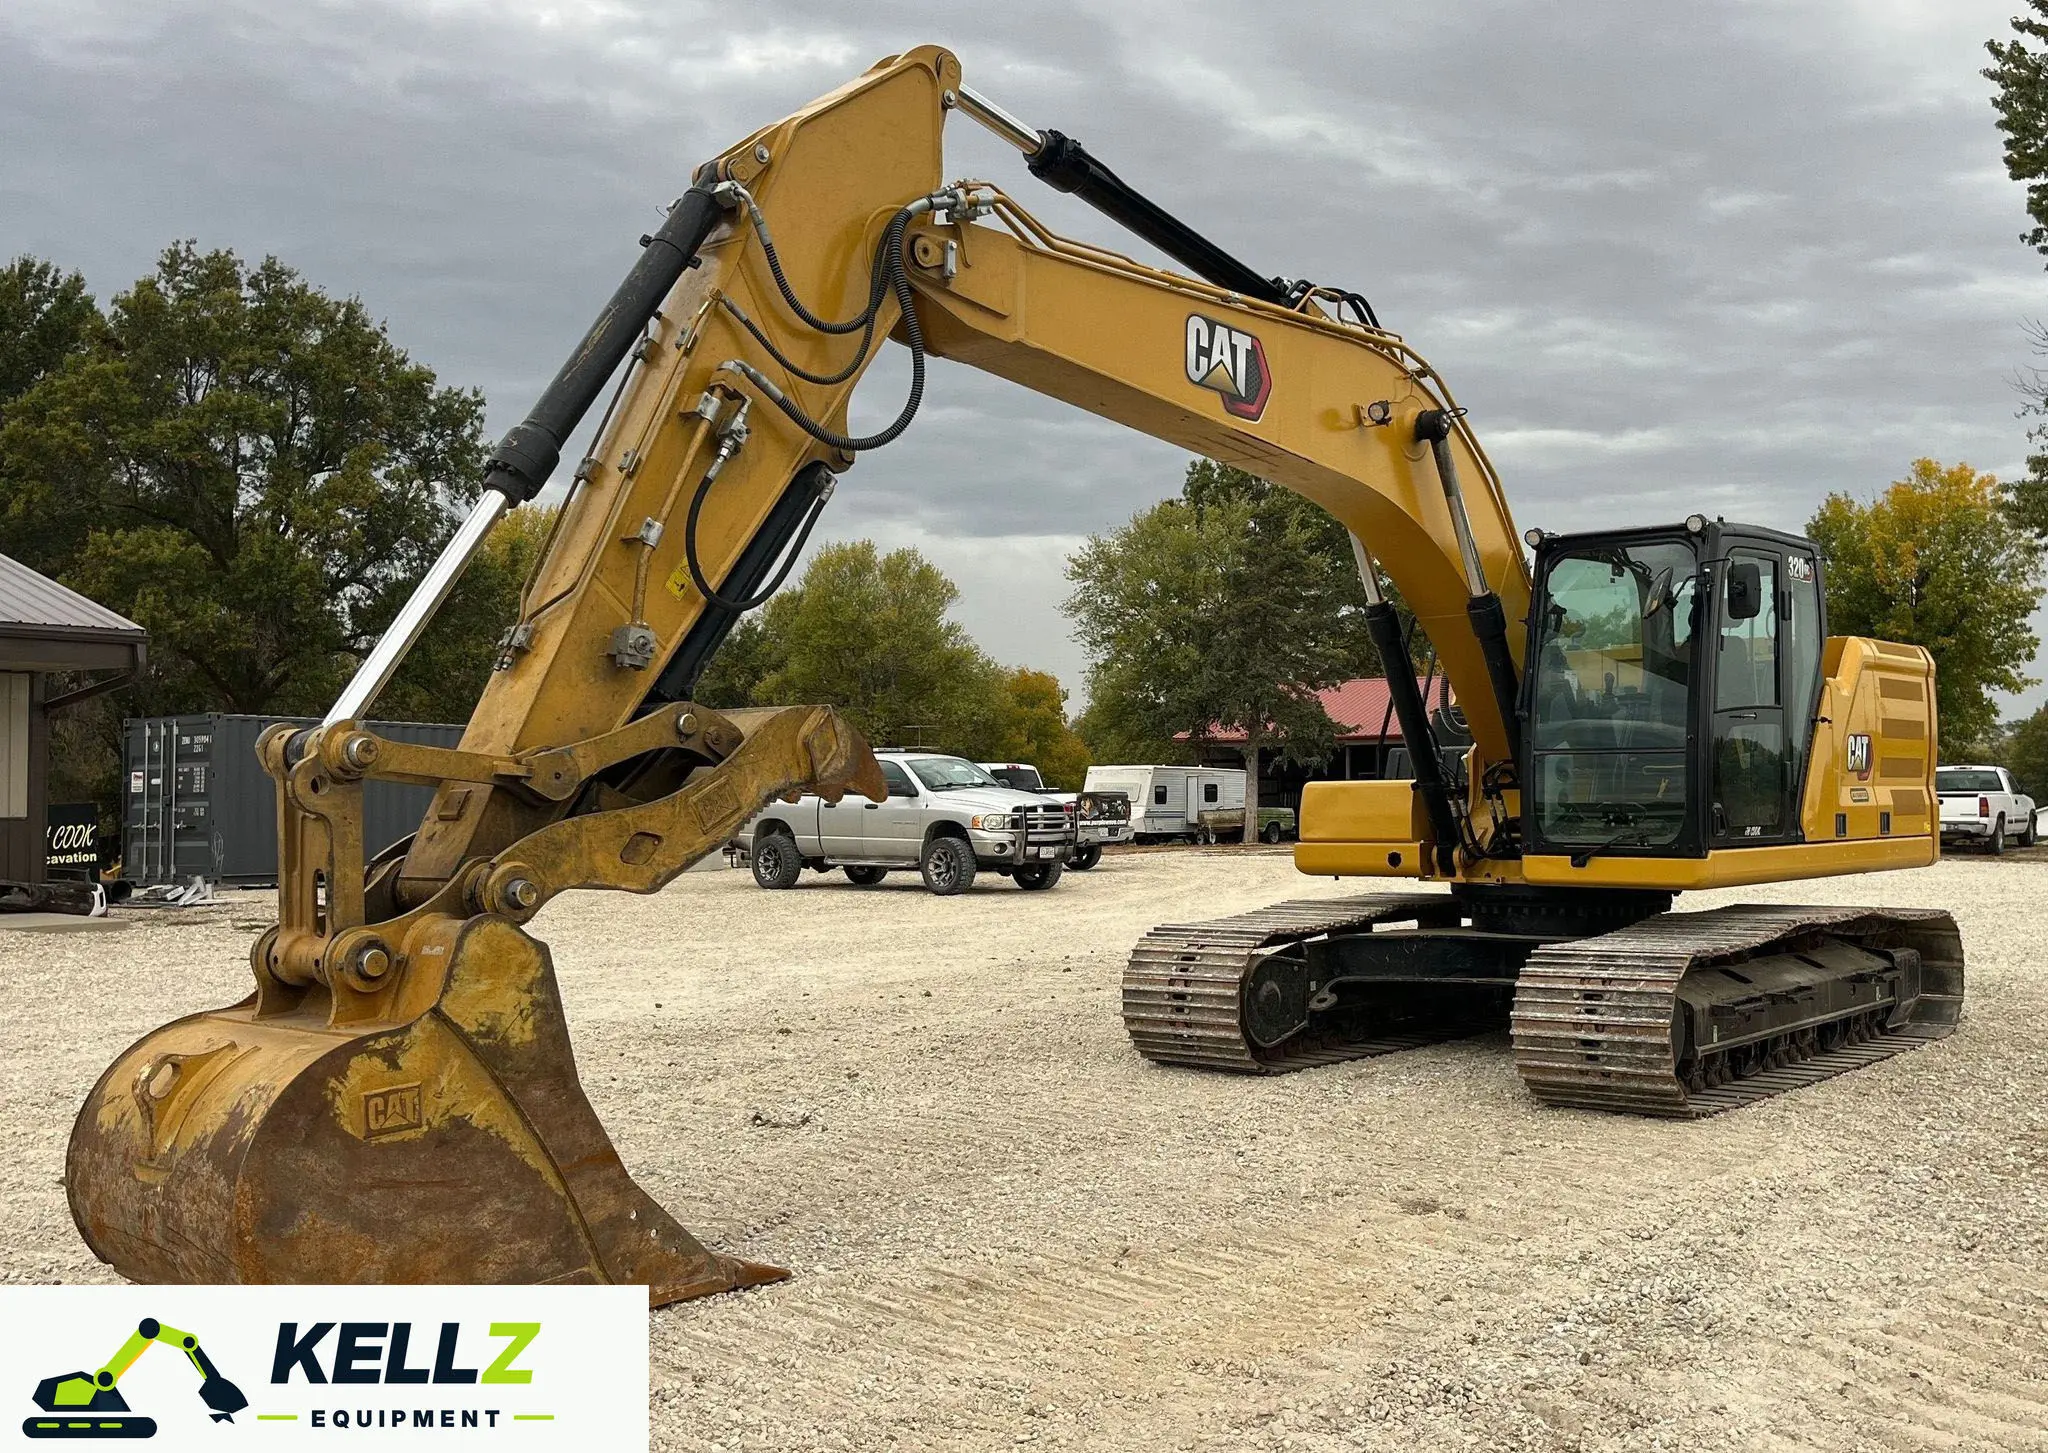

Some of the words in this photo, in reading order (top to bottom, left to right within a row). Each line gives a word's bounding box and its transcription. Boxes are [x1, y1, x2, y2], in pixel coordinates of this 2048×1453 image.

[1187, 315, 1252, 398] CAT
[1788, 556, 1804, 578] 320
[1847, 735, 1869, 771] CAT
[53, 824, 97, 850] COOK
[367, 1088, 419, 1130] CAT
